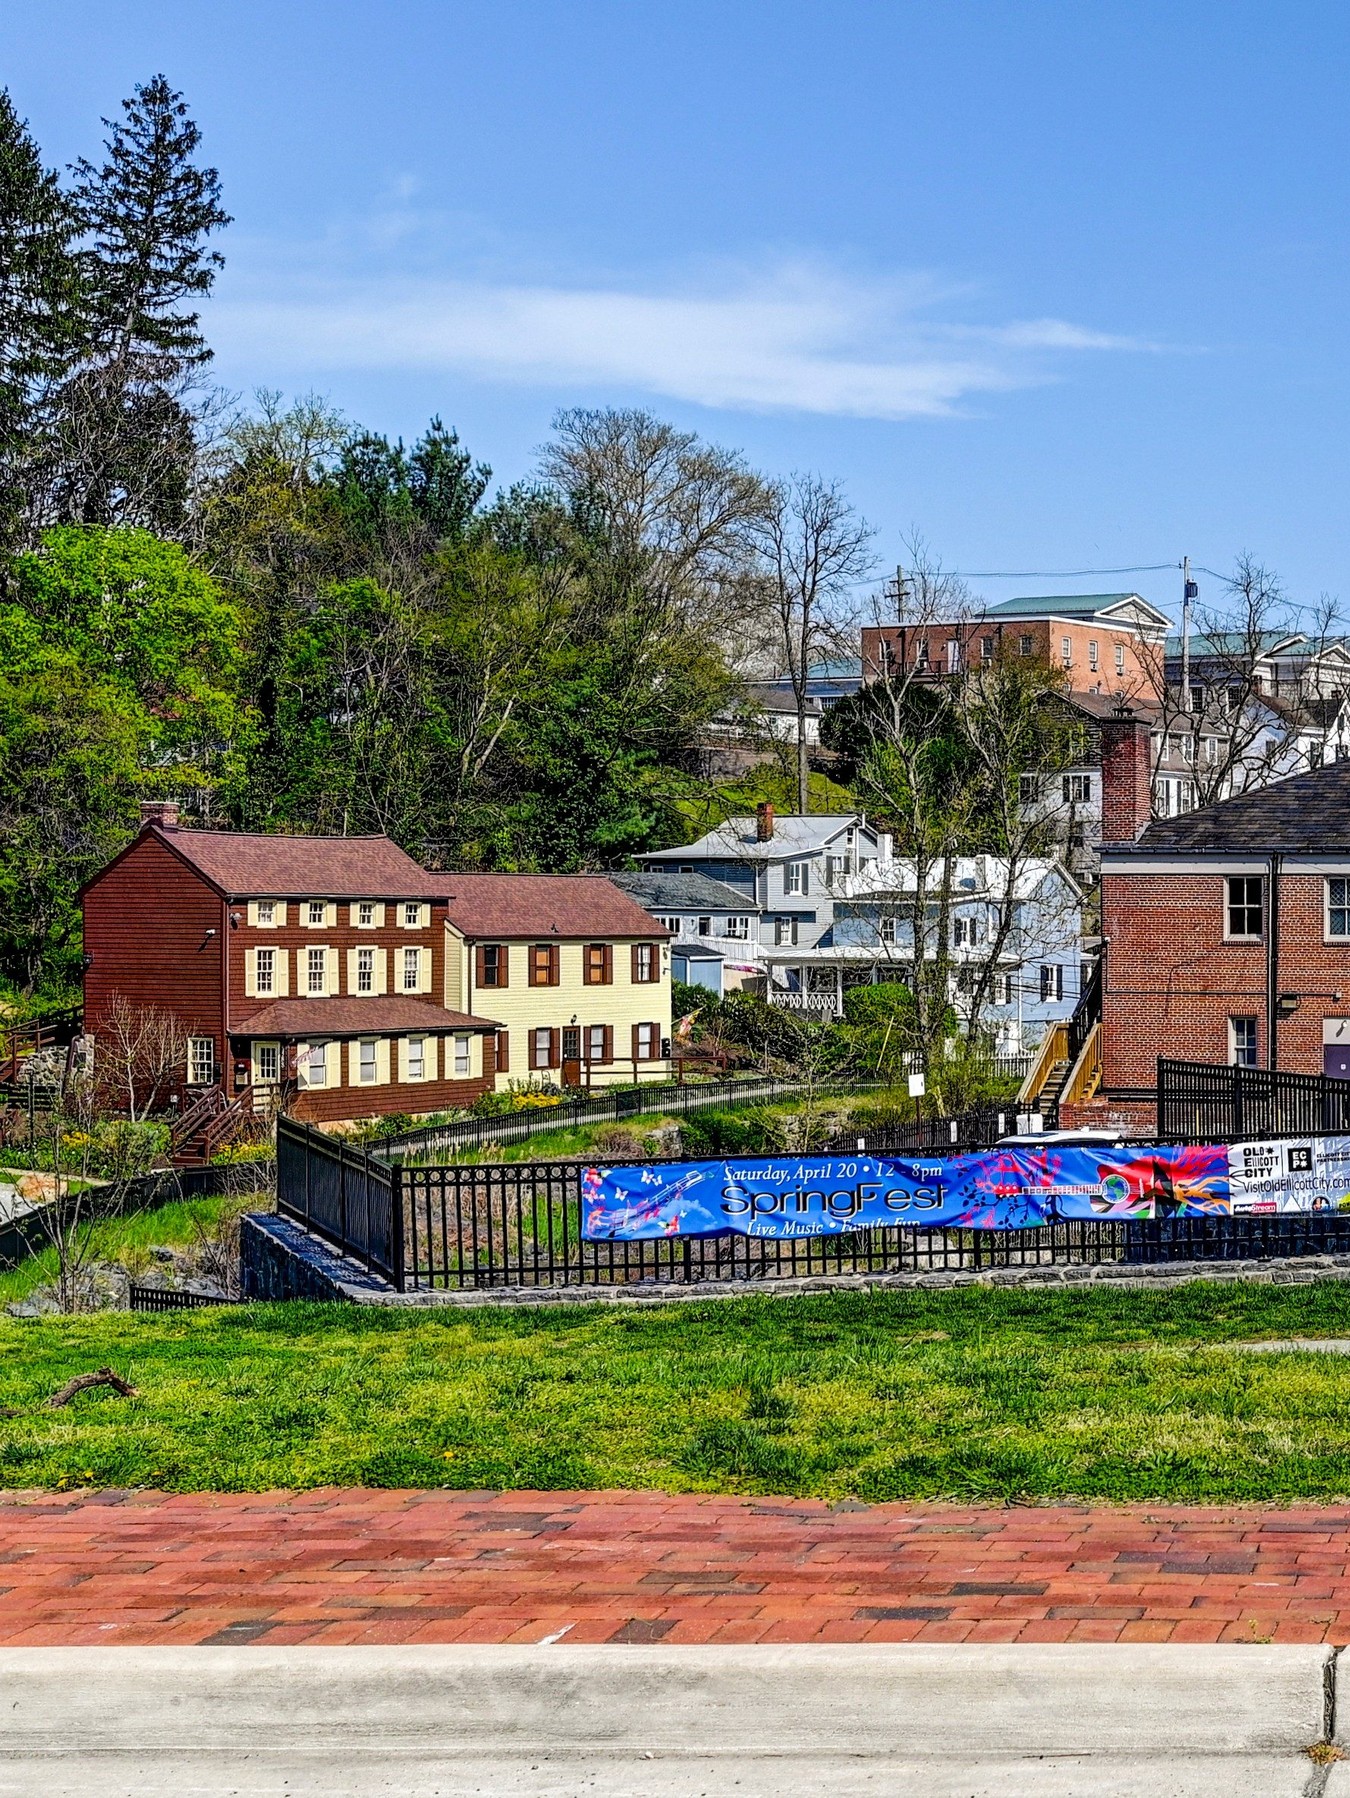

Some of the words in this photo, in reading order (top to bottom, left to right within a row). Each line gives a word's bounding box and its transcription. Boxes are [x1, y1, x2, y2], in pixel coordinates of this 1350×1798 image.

[1243, 1147, 1264, 1157] OLD
[1292, 1151, 1307, 1160] EC
[723, 1166, 790, 1185] Saturday,
[794, 1163, 831, 1184] April
[837, 1163, 857, 1178] 20
[875, 1163, 894, 1177] 12
[911, 1164, 943, 1182] 8pm
[1245, 1168, 1272, 1178] CITY
[720, 1183, 949, 1220] SpringFest
[1235, 1203, 1276, 1213] AutoStream
[747, 1222, 777, 1236] Live
[781, 1221, 824, 1235] Music
